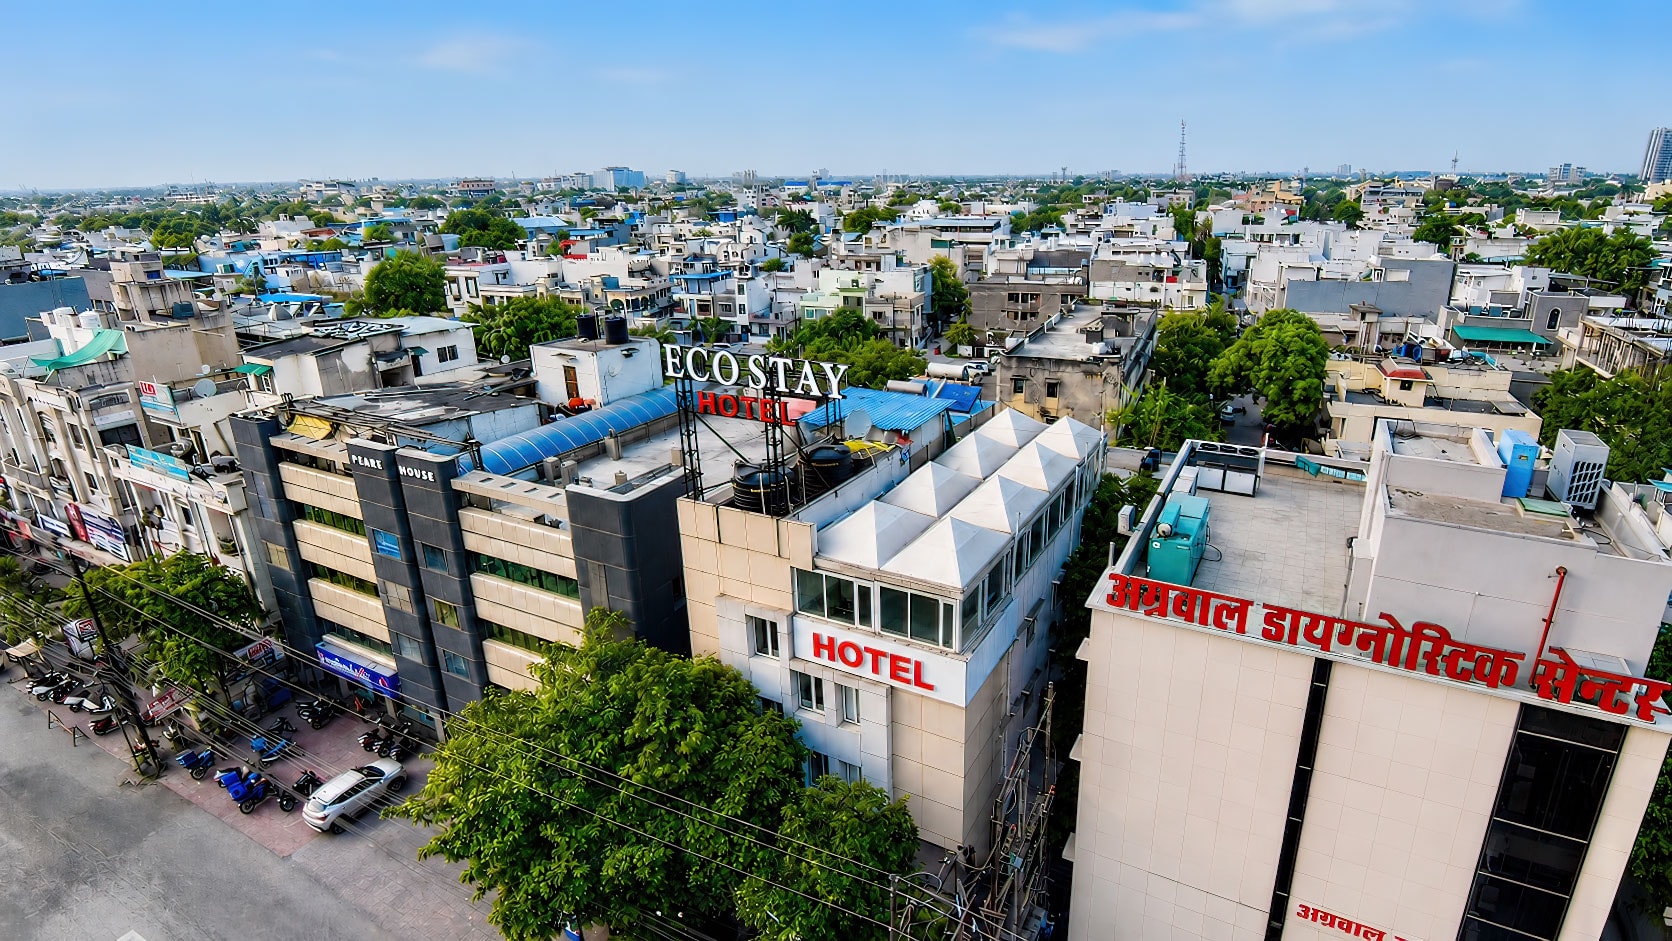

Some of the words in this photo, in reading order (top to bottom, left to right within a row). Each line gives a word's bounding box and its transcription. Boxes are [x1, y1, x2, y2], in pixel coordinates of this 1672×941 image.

[663, 344, 740, 386] ECO
[748, 354, 850, 399] STAY
[697, 390, 797, 426] HOTEL
[398, 465, 435, 482] HOUSE
[812, 631, 935, 692] HOTEL
